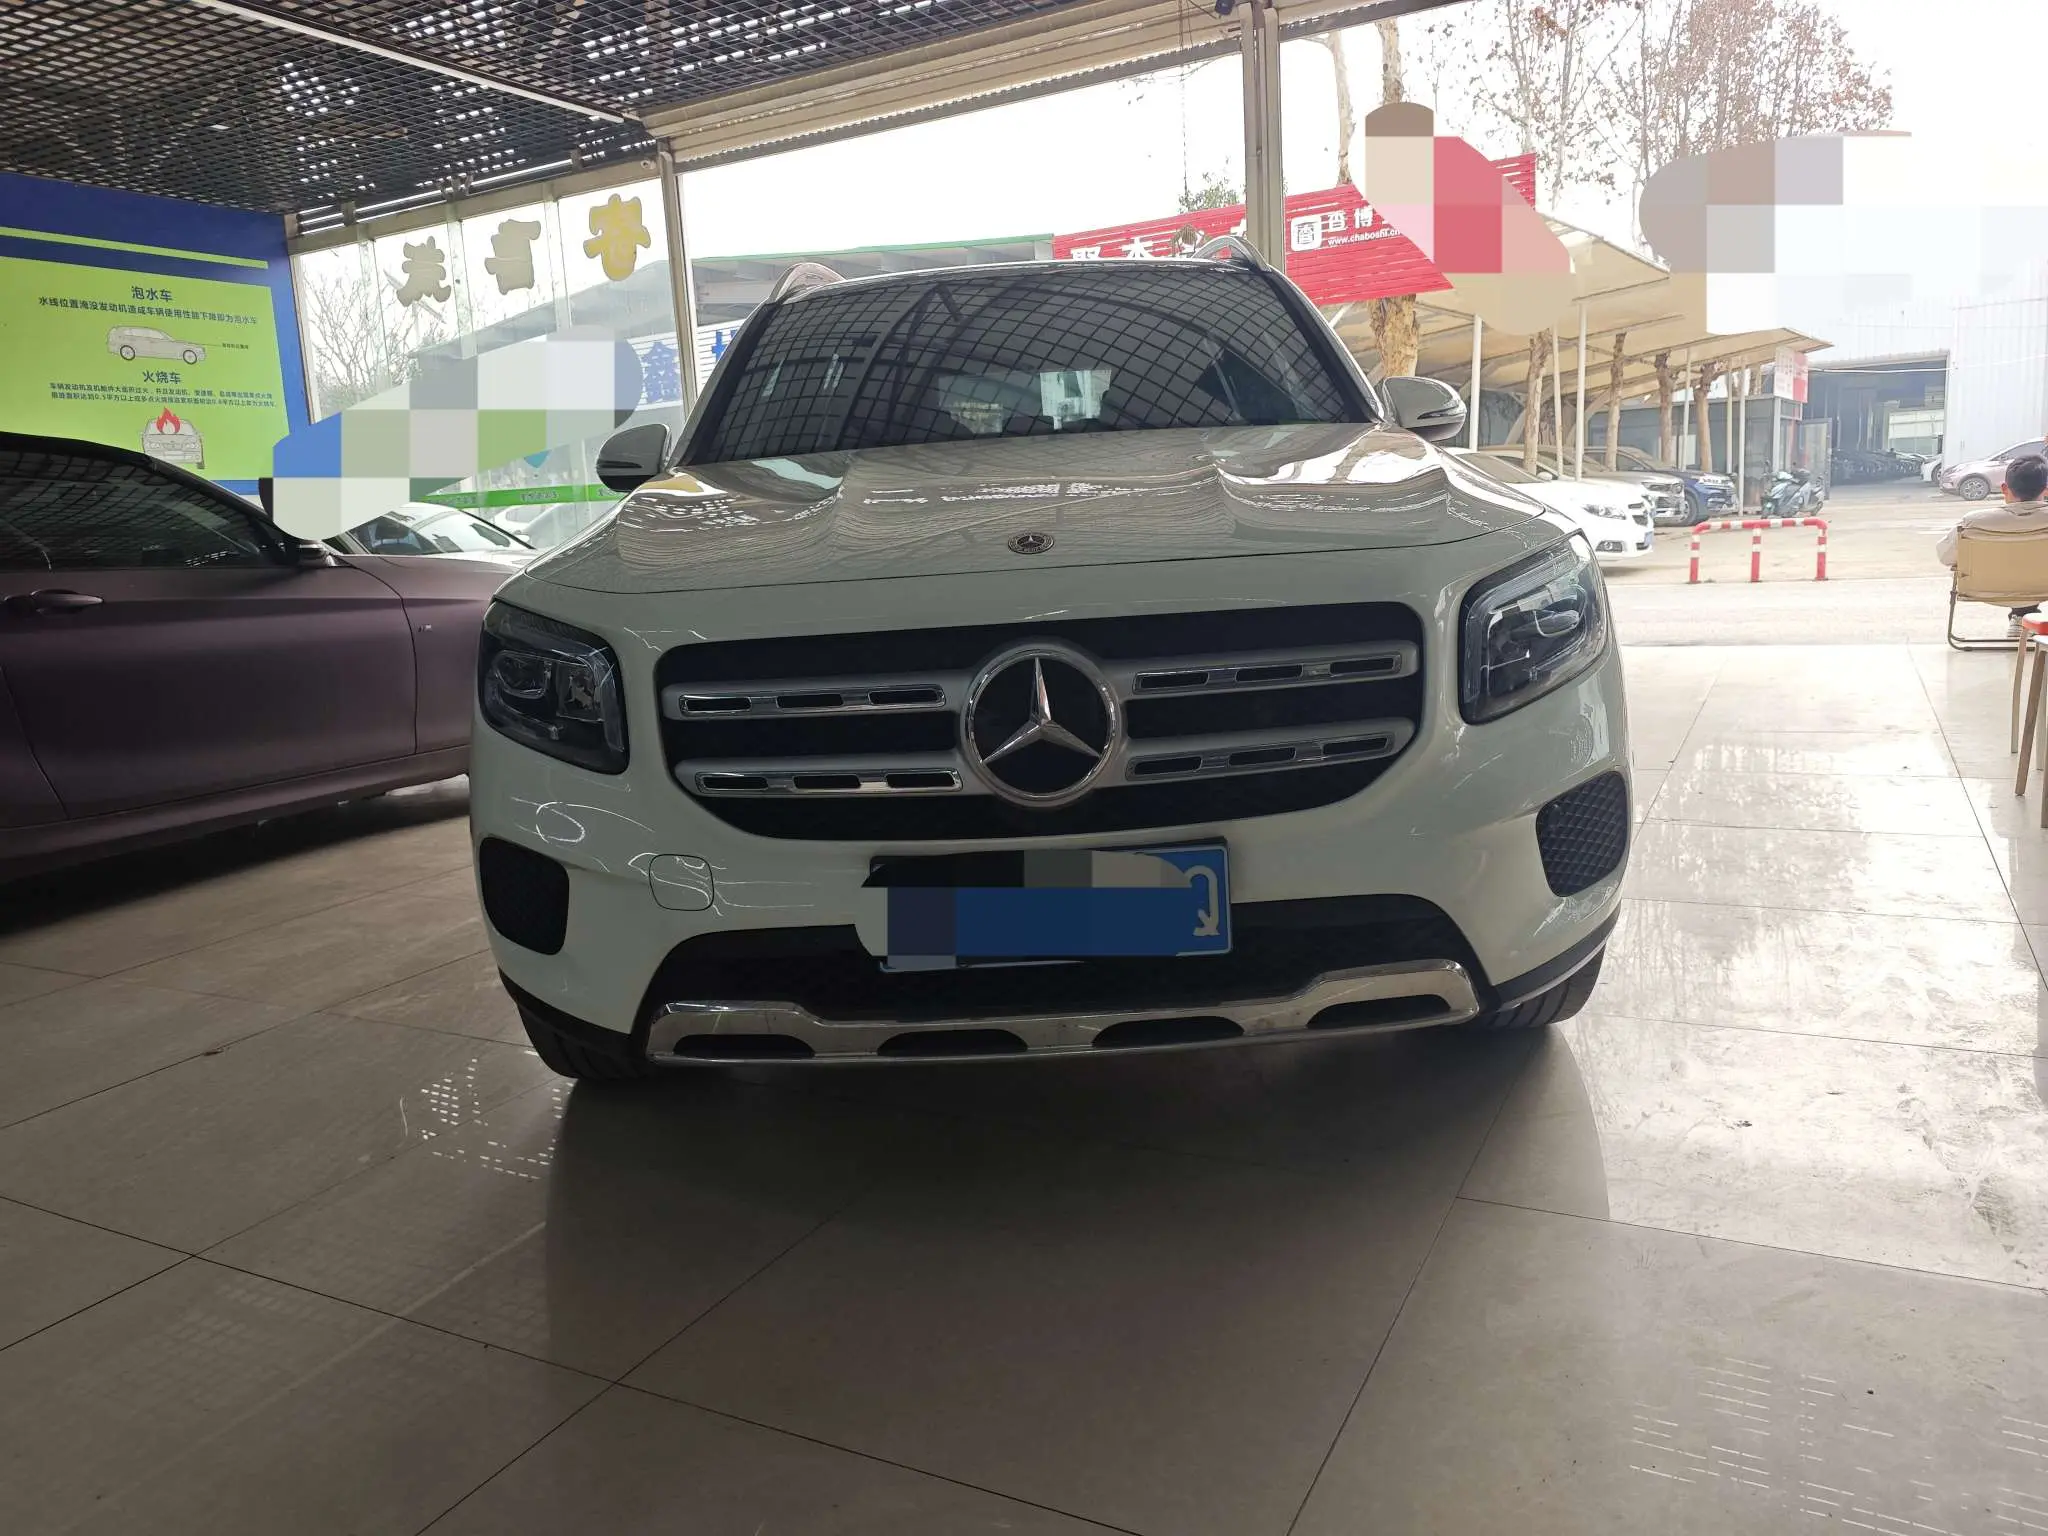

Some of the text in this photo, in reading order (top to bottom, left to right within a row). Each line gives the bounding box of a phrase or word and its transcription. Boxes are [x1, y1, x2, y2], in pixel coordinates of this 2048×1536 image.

[1327, 204, 1389, 232] 查博
[131, 285, 173, 302] 泡水车
[143, 370, 181, 384] 火烧车
